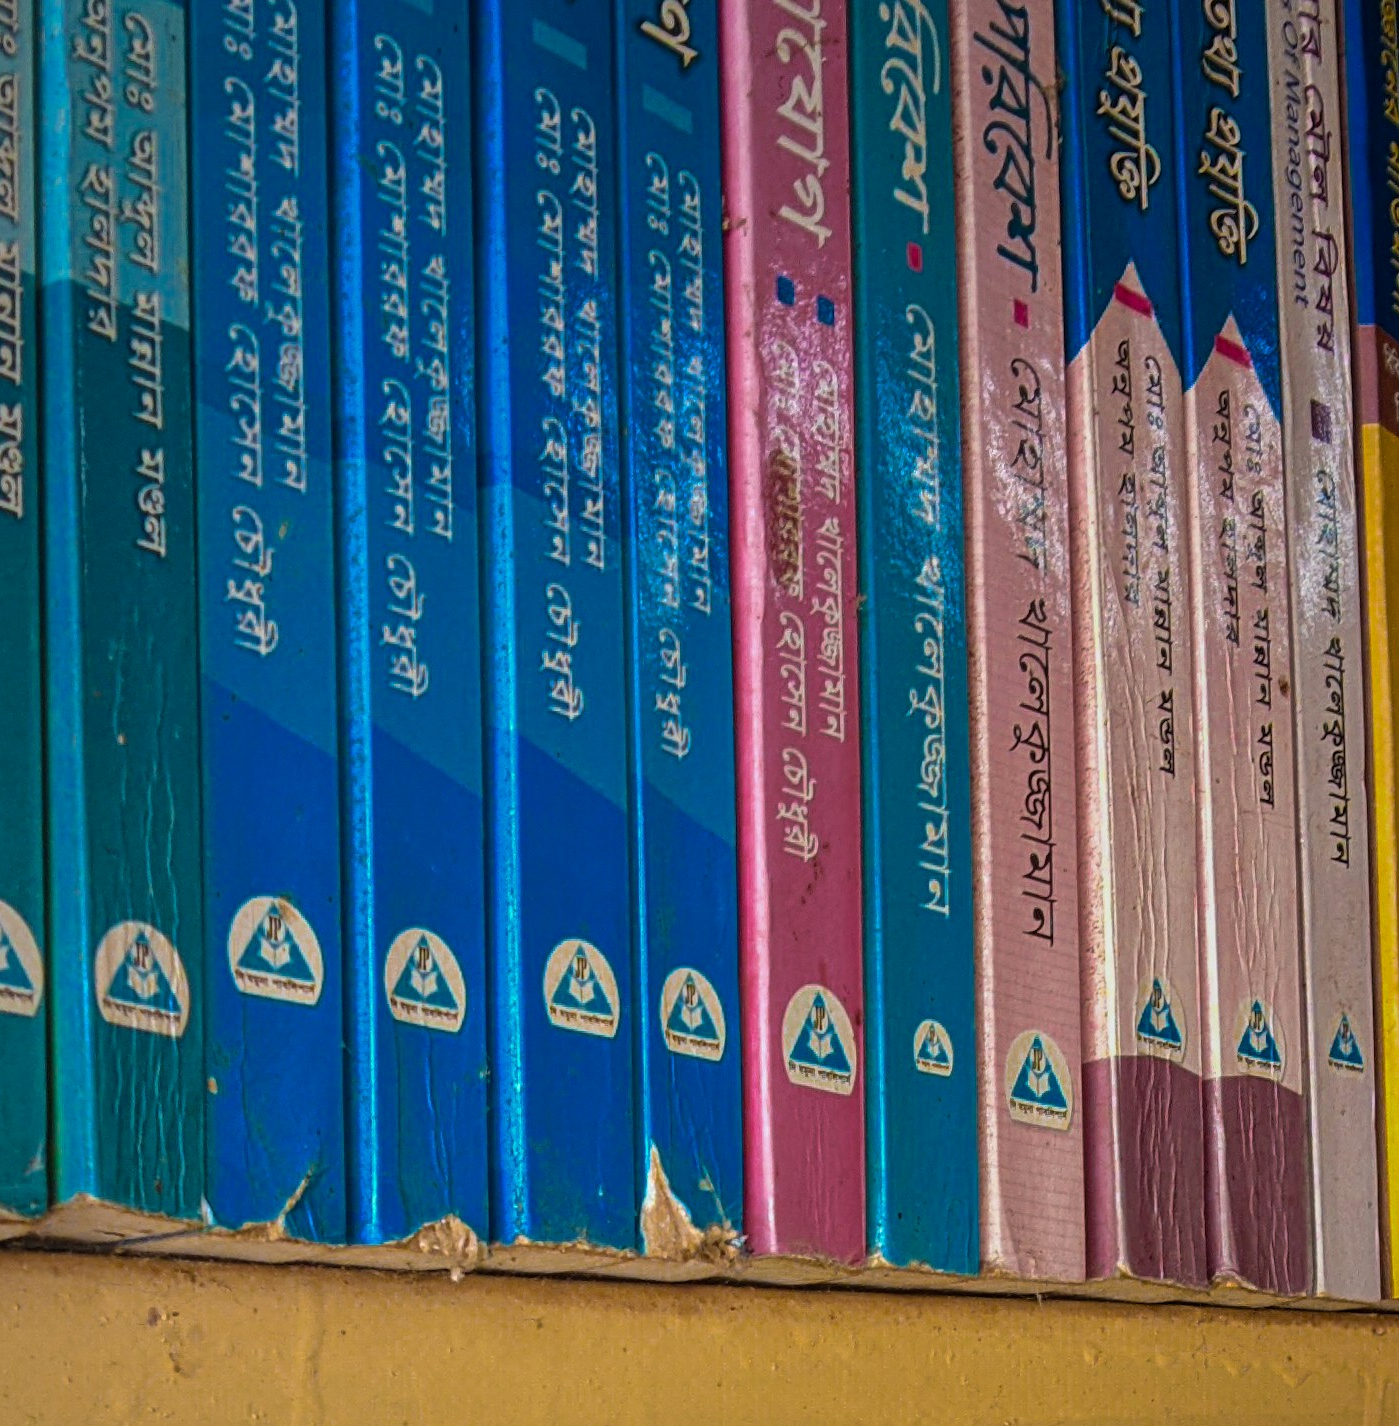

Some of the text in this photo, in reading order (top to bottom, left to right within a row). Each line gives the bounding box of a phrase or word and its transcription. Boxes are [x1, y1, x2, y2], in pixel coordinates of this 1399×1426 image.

[124, 11, 158, 113] মোঃ
[373, 32, 405, 128] মোঃ
[1096, 45, 1163, 212] প্রযুক্তি
[972, 2, 1054, 295] পরিবেশ
[1198, 107, 1259, 266] প্রযুক্তি
[80, 164, 117, 342] হালদার
[129, 290, 164, 430] মান্নান
[225, 323, 265, 489] হোসেন
[378, 378, 416, 534] হোসেন
[225, 505, 278, 658] চৌধুরী
[379, 552, 429, 699] চৌধুরী
